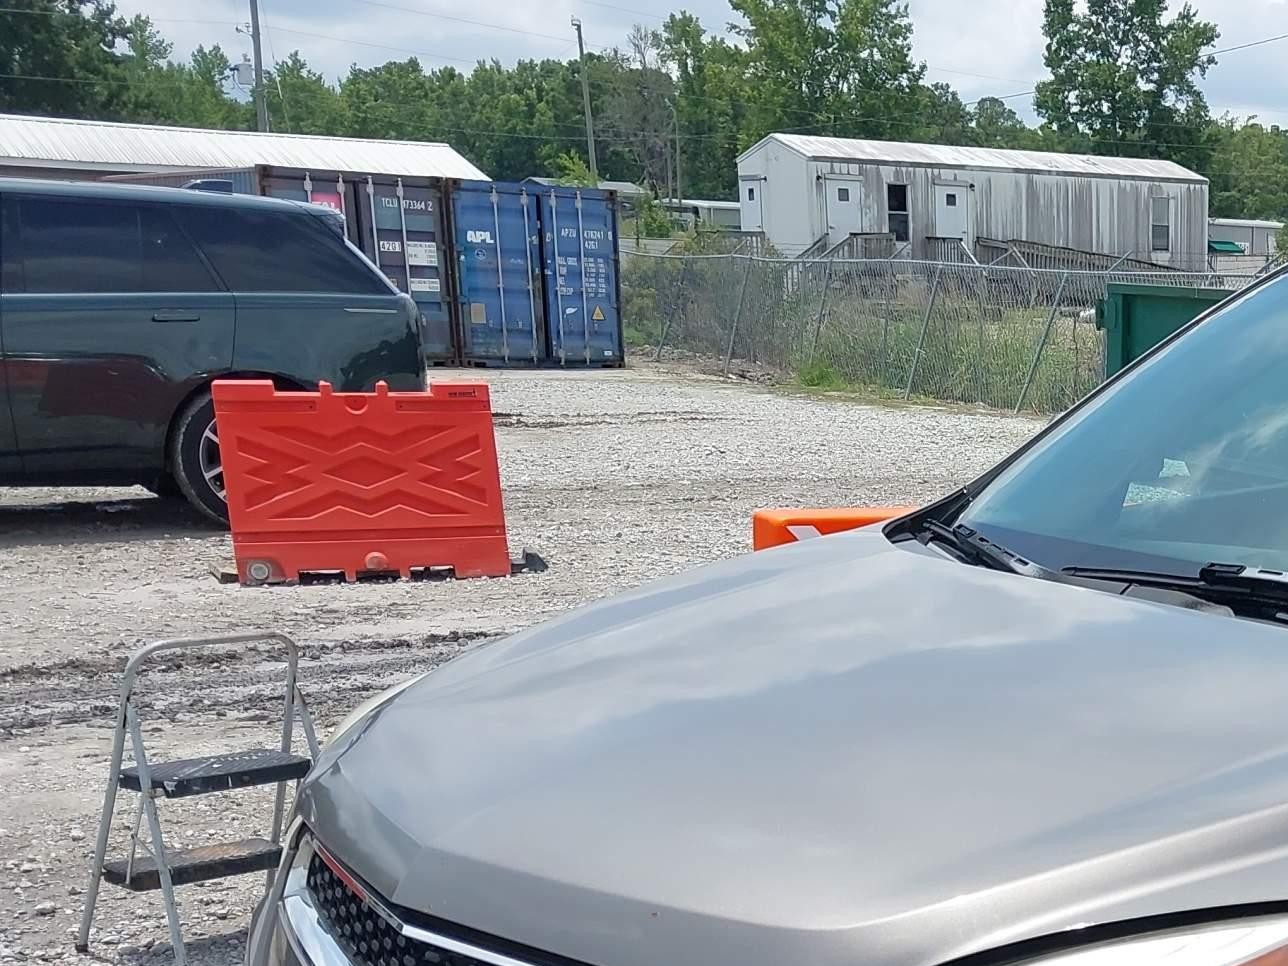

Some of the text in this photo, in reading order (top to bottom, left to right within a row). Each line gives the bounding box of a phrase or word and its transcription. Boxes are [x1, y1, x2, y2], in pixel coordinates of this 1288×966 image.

[381, 198, 398, 208] TCLU
[466, 230, 494, 244] APL
[561, 228, 577, 238] APZU
